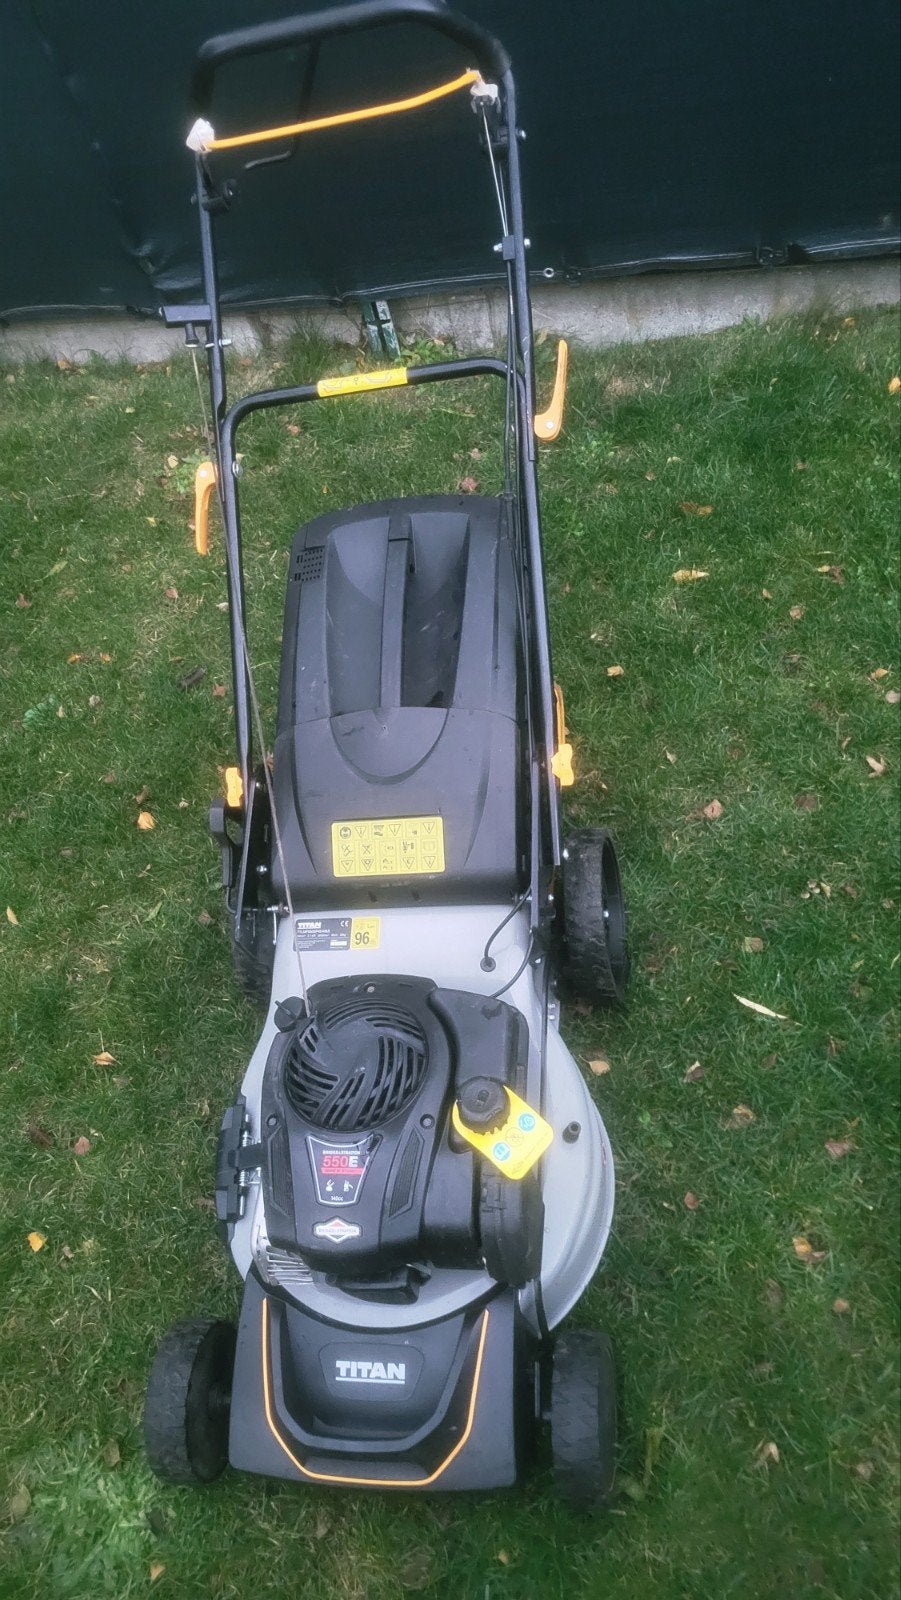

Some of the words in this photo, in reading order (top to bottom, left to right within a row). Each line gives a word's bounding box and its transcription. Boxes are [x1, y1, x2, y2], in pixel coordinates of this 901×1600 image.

[354, 931, 370, 945] 96
[323, 1155, 359, 1168] 550E
[335, 1360, 406, 1380] TITAN
